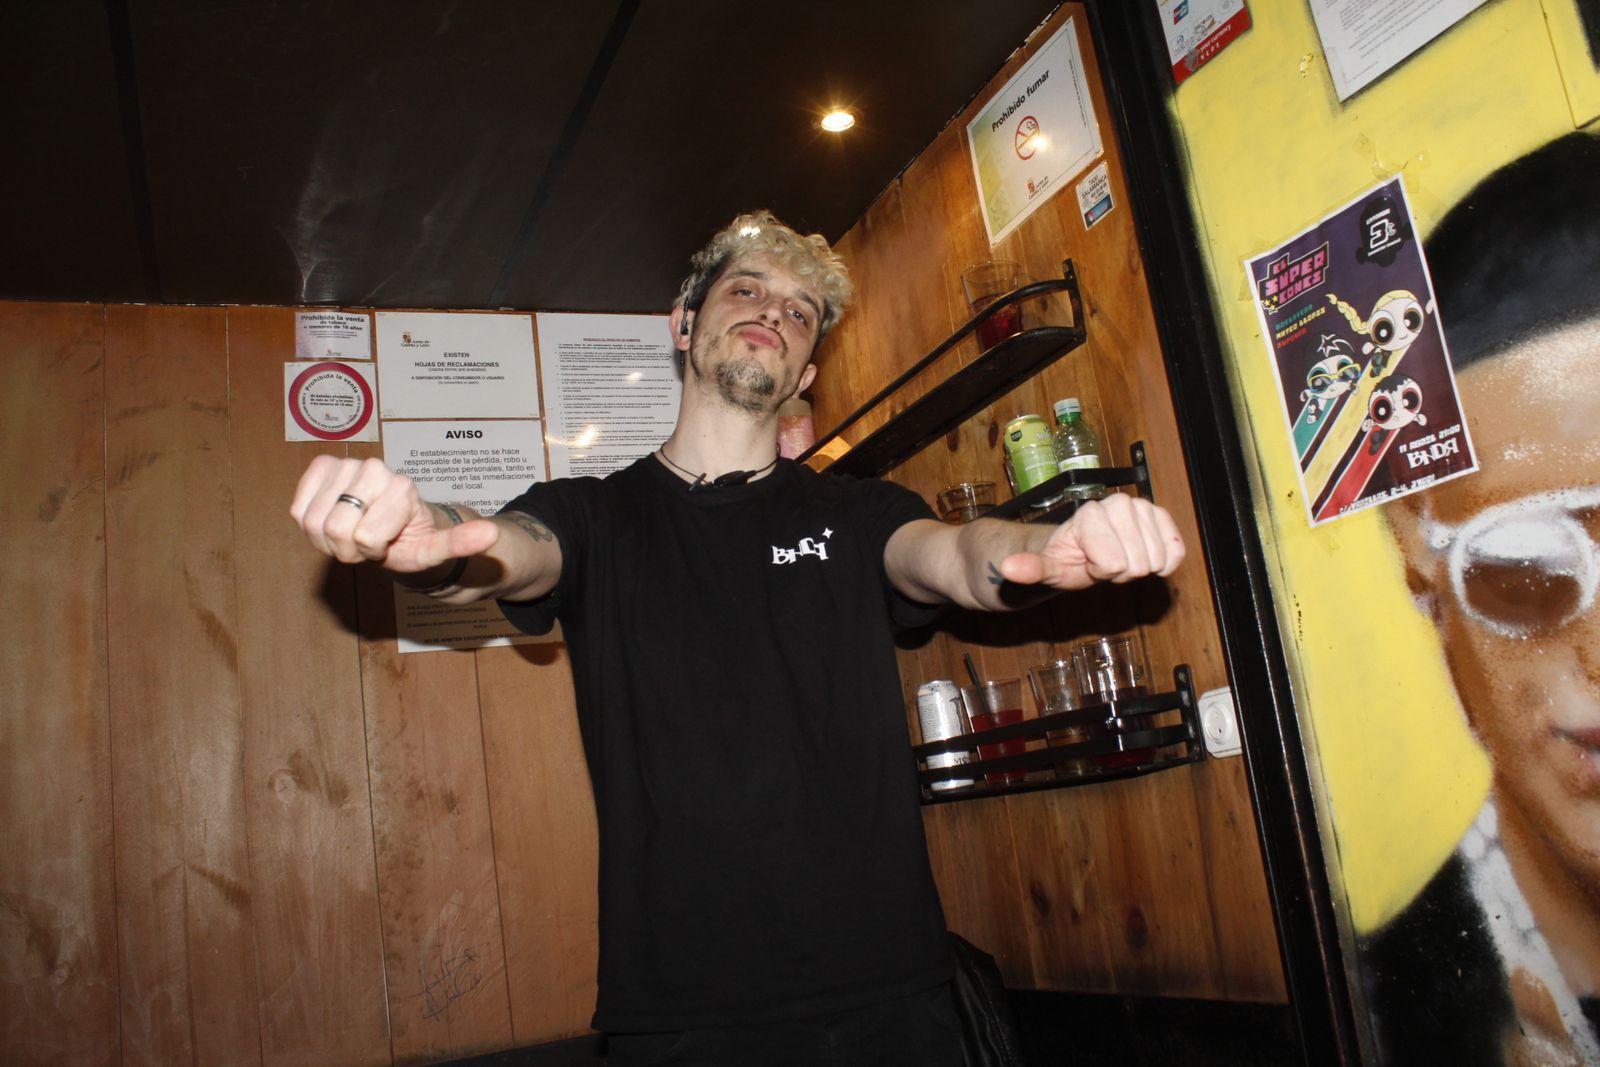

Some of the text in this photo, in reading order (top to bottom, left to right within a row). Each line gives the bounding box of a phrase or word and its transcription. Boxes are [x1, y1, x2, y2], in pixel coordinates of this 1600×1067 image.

[991, 69, 1049, 132] Prohibido fumar
[1265, 250, 1325, 297] SUPER
[304, 373, 335, 391] Prohibida
[344, 378, 358, 394] venta
[445, 430, 483, 439] AVISO
[420, 449, 478, 457] establecimiento
[404, 457, 450, 467] responsable
[472, 456, 502, 466] pérdida,
[396, 466, 419, 475] olvido
[421, 466, 431, 474] de
[432, 465, 460, 475] objetos
[461, 464, 503, 474] personales,
[505, 464, 524, 472] tanto
[482, 472, 535, 481] inmediaciones
[452, 481, 484, 490] del local.
